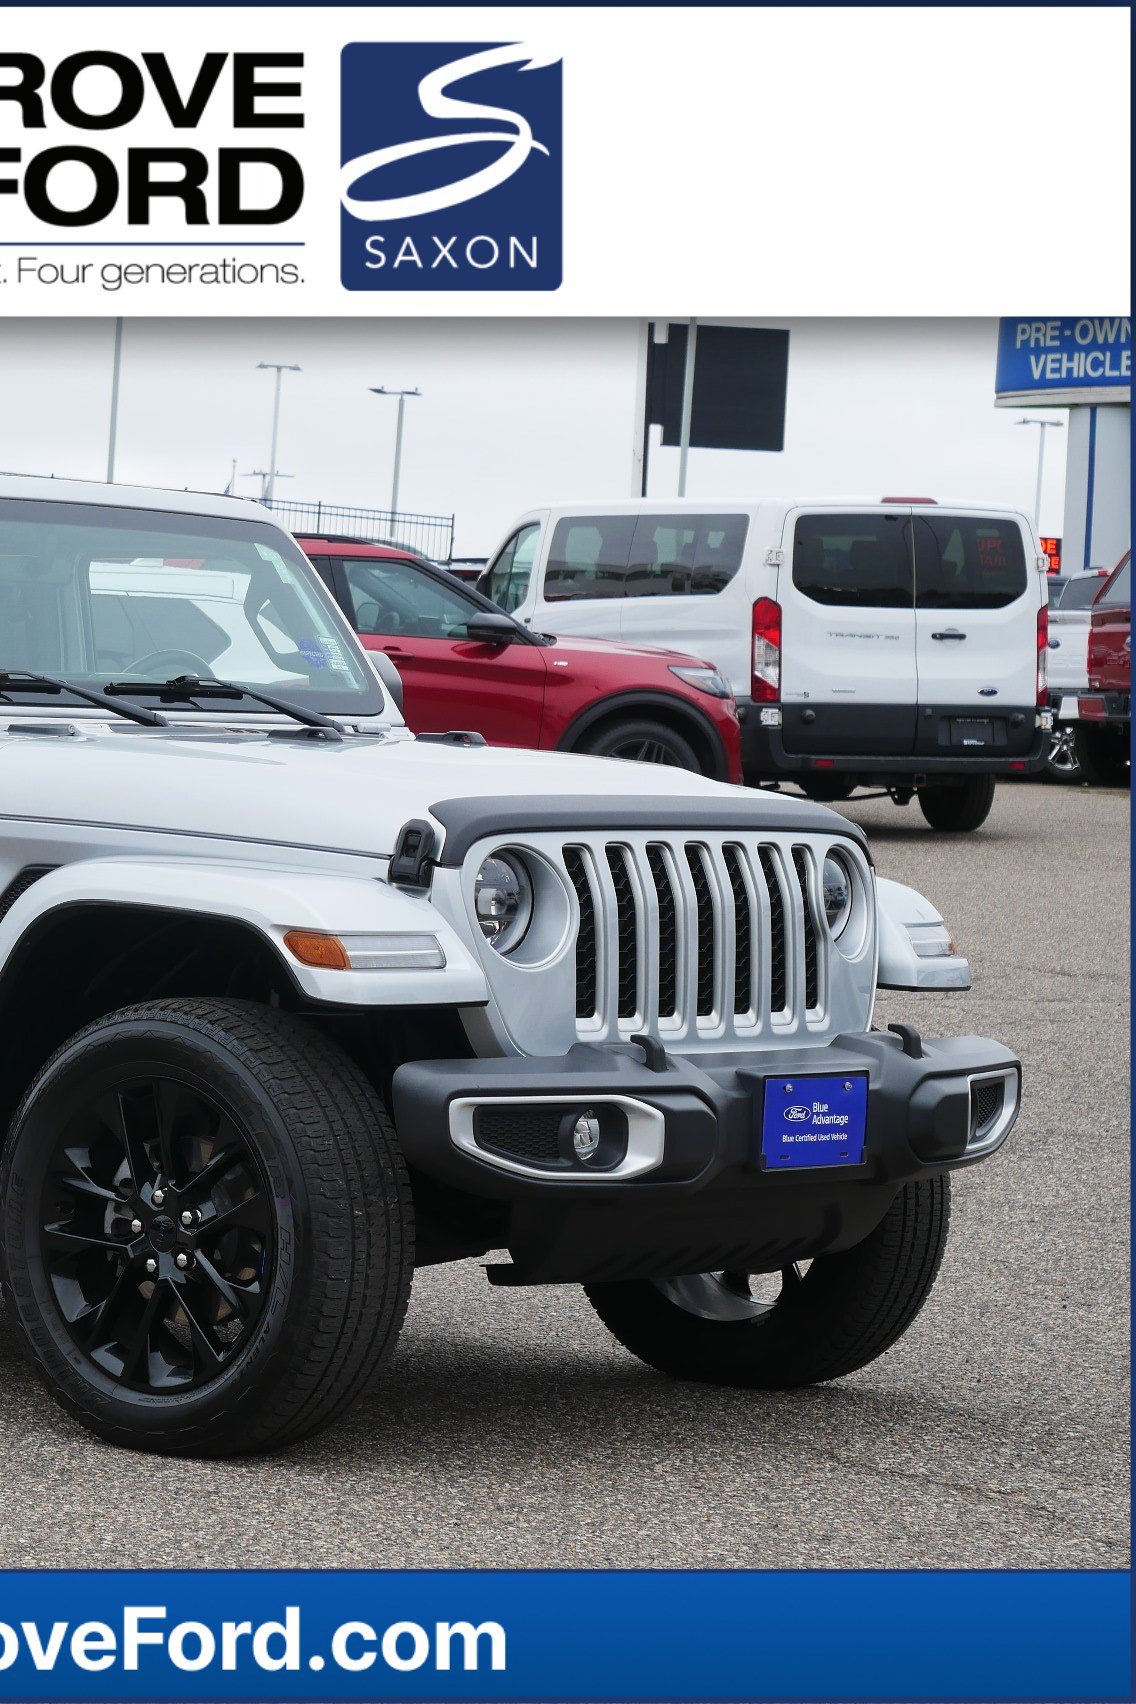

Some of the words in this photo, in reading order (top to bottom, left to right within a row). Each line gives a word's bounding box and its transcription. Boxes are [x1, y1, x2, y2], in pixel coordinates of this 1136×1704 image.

[812, 1102, 829, 1113] Blue
[786, 1106, 809, 1121] Ford
[812, 1114, 849, 1126] Advantage
[782, 1134, 795, 1143] Blue
[795, 1133, 817, 1143] Certified
[817, 1133, 831, 1142] Used
[831, 1132, 848, 1141] Vehicle
